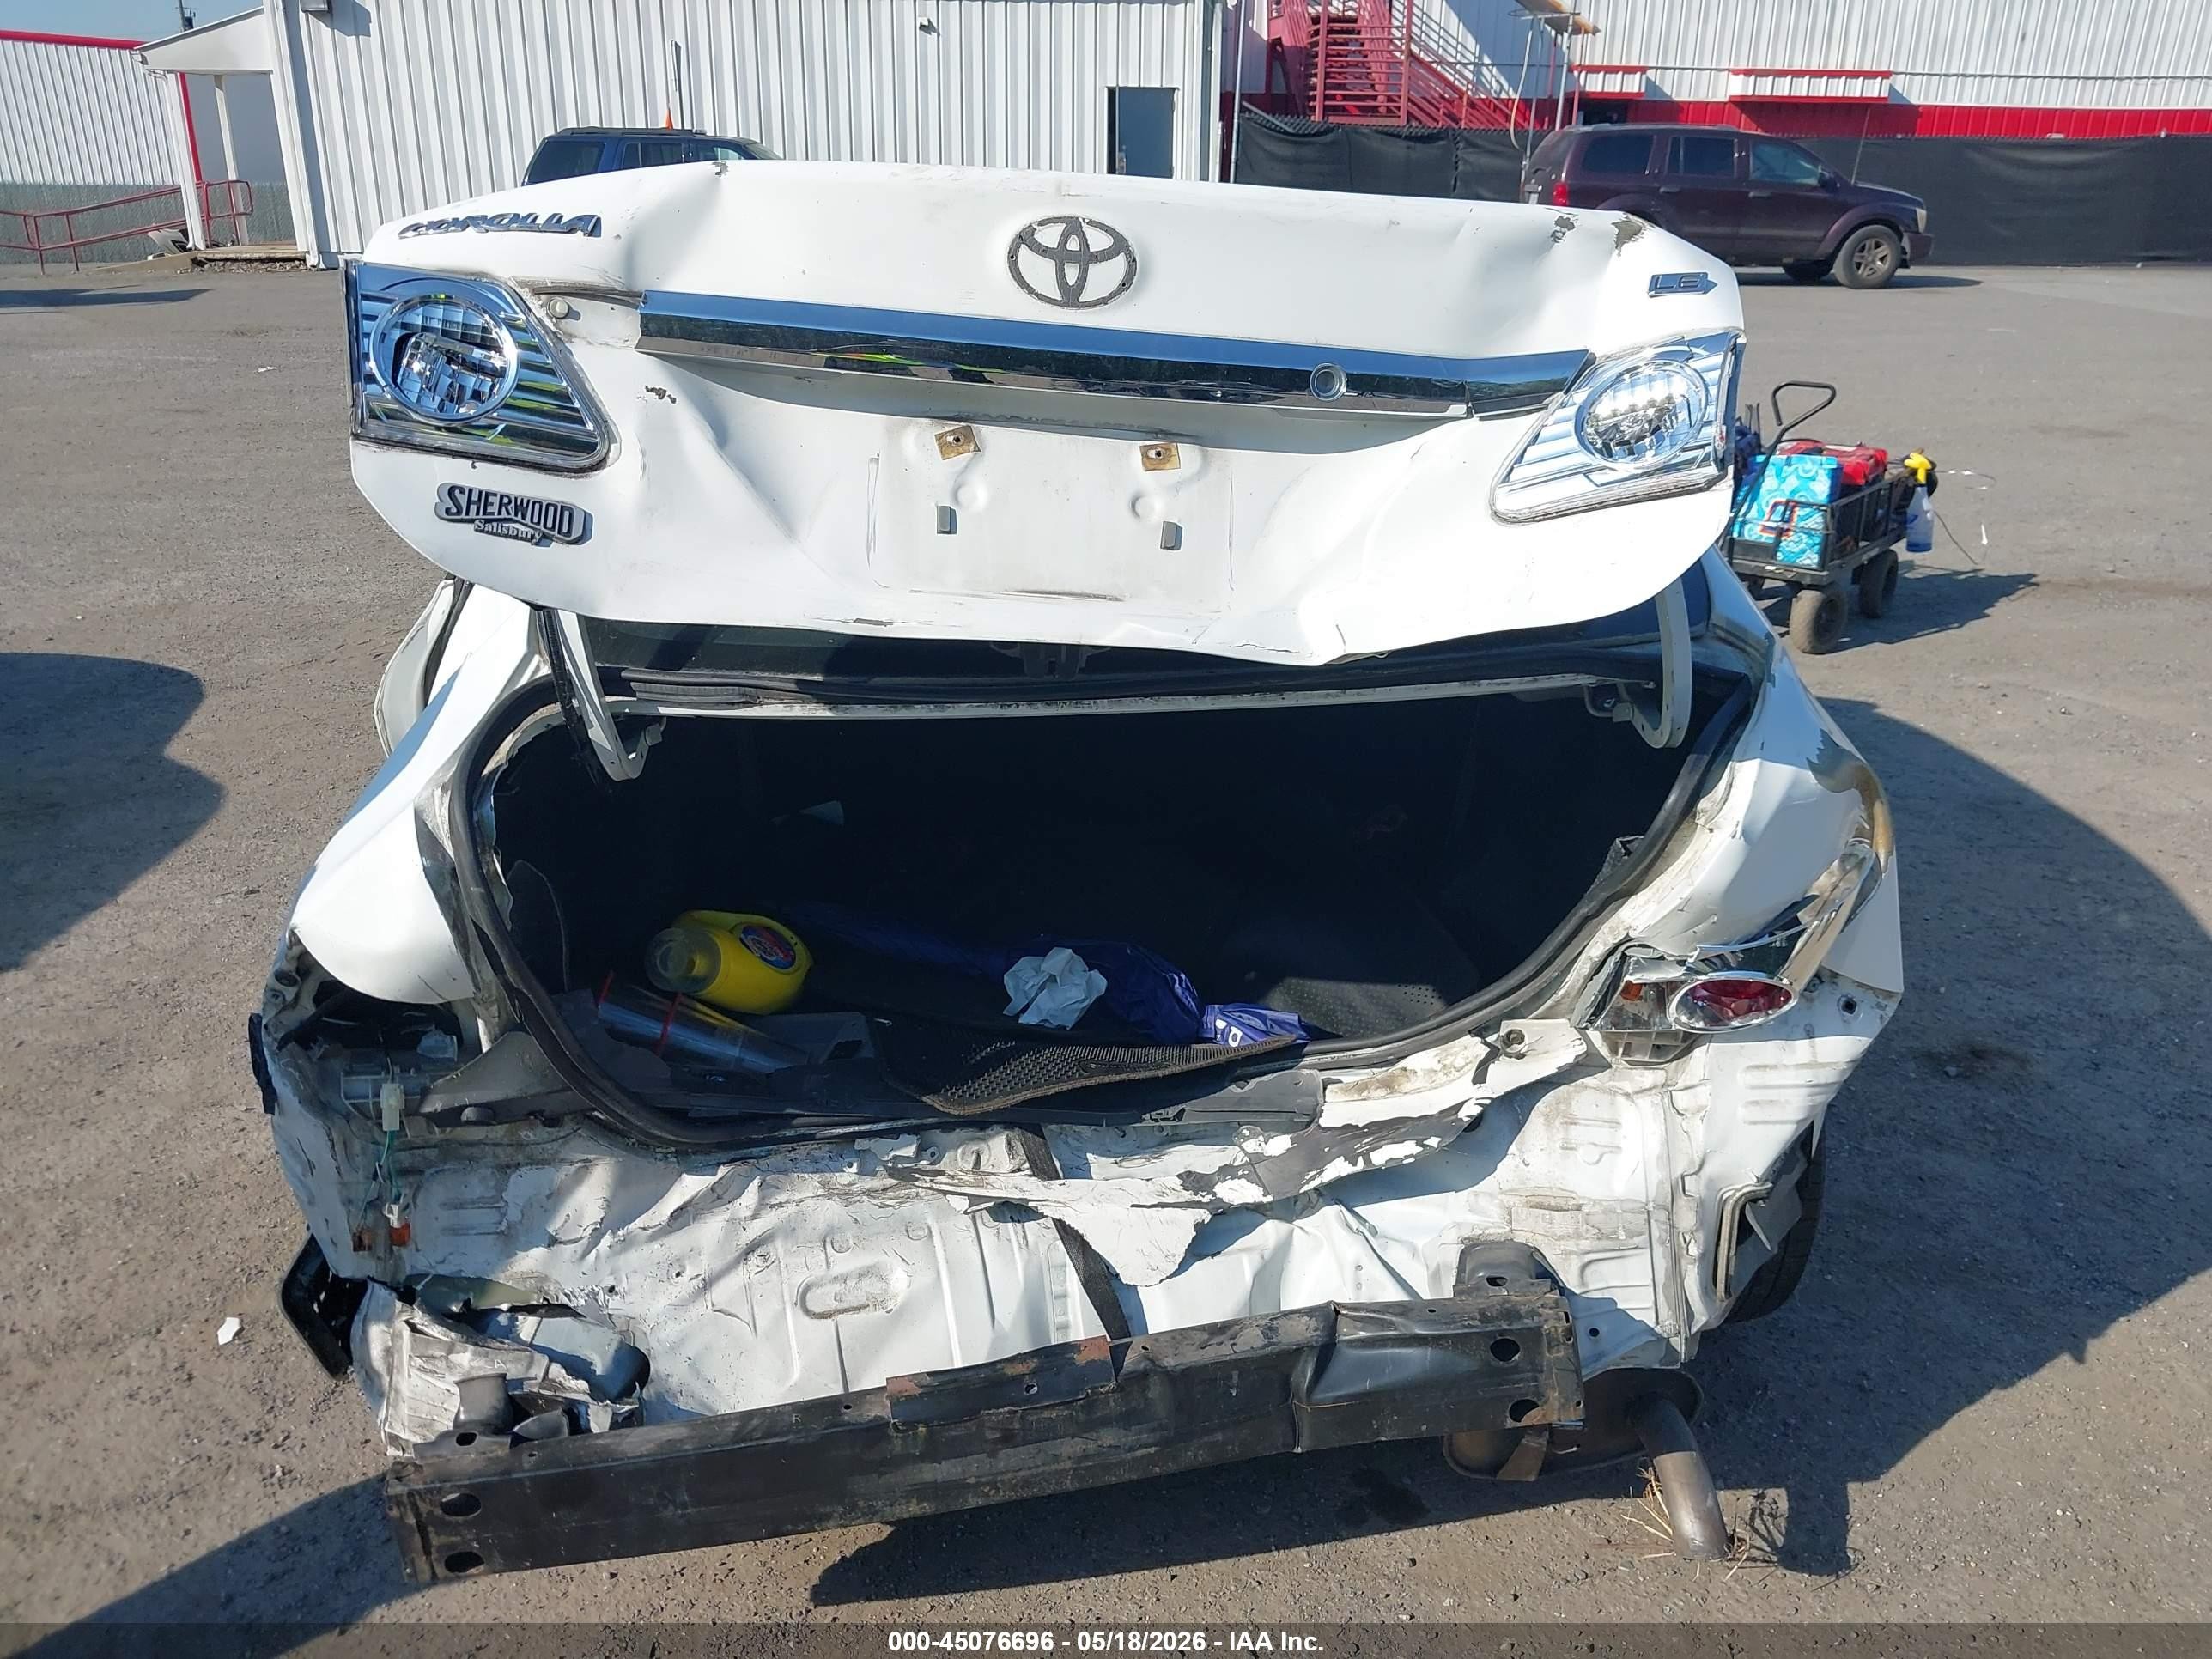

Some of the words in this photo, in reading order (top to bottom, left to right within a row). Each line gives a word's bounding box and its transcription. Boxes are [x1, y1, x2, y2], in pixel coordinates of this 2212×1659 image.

[398, 212, 602, 239] COROLLA
[1649, 272, 1708, 296] LE
[444, 484, 575, 538] SHERWOOD
[473, 518, 544, 546] Salisbury
